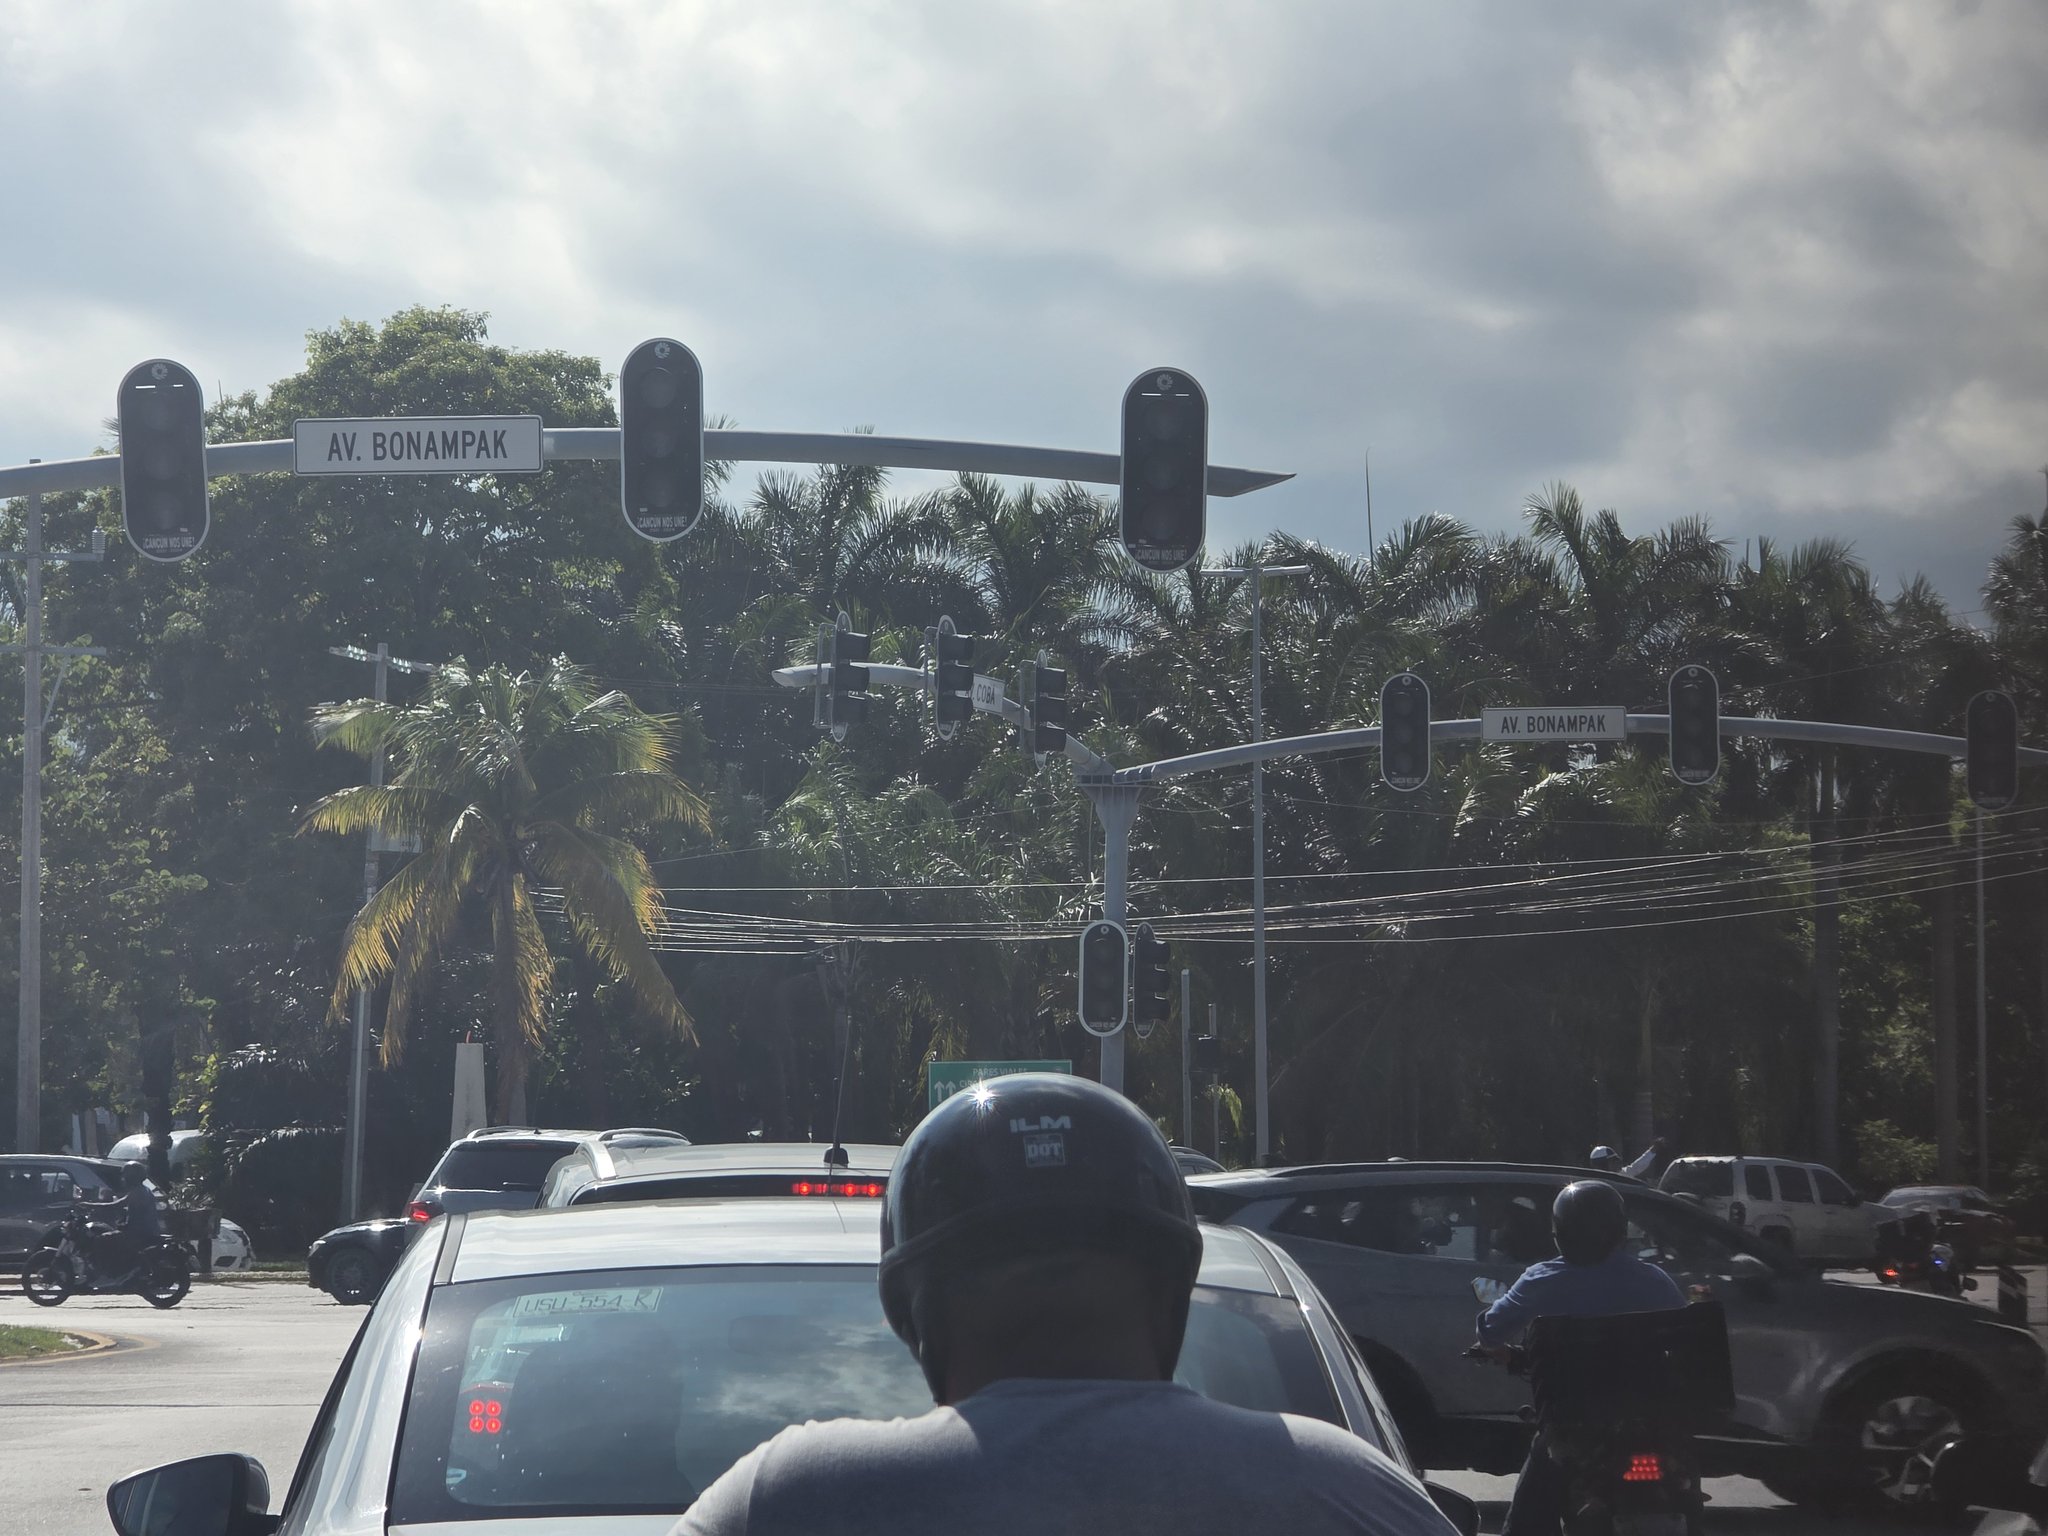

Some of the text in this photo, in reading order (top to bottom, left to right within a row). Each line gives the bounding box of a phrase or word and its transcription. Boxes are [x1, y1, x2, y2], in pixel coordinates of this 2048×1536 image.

[327, 430, 508, 461] AV. BONAMPAK
[1501, 714, 1606, 734] AV. BONAMPAK
[1009, 1115, 1071, 1133] ILM
[1027, 1142, 1061, 1158] DOT
